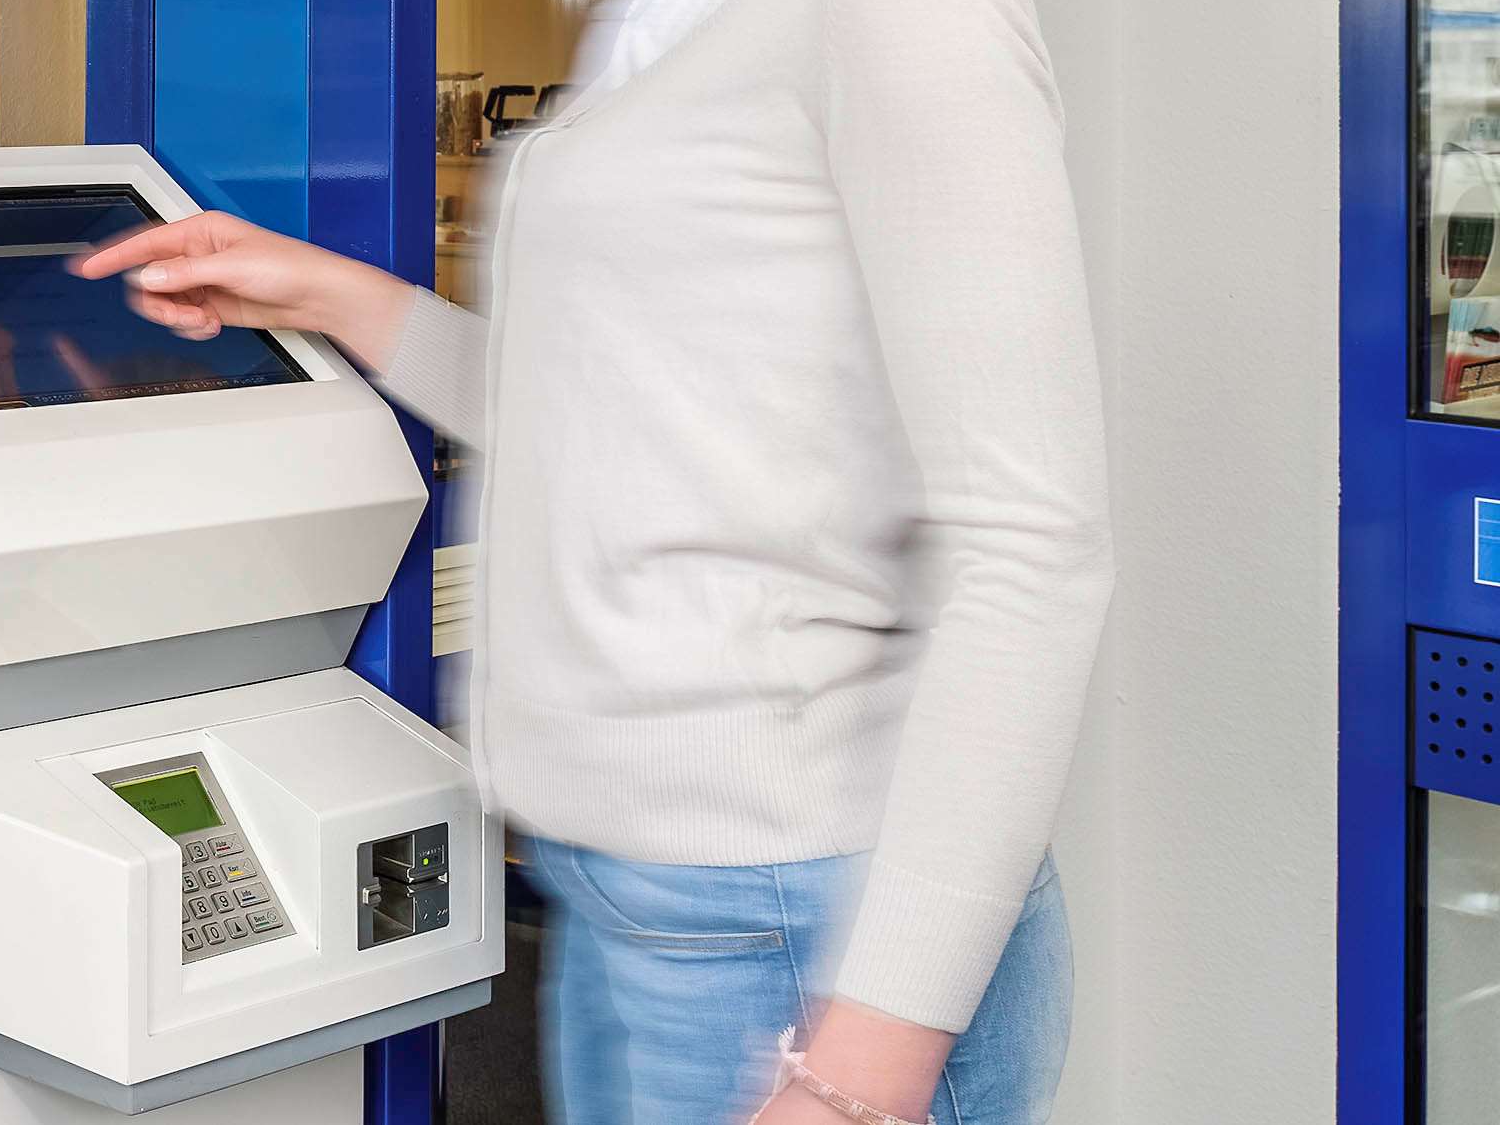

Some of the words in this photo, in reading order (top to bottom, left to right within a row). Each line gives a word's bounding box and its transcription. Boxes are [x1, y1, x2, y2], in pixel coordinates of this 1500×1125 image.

[194, 846, 203, 857] 3
[184, 876, 193, 887] 5
[207, 871, 215, 882] 6
[197, 901, 206, 913] 8
[219, 896, 229, 907] 9
[210, 927, 219, 938] 0
